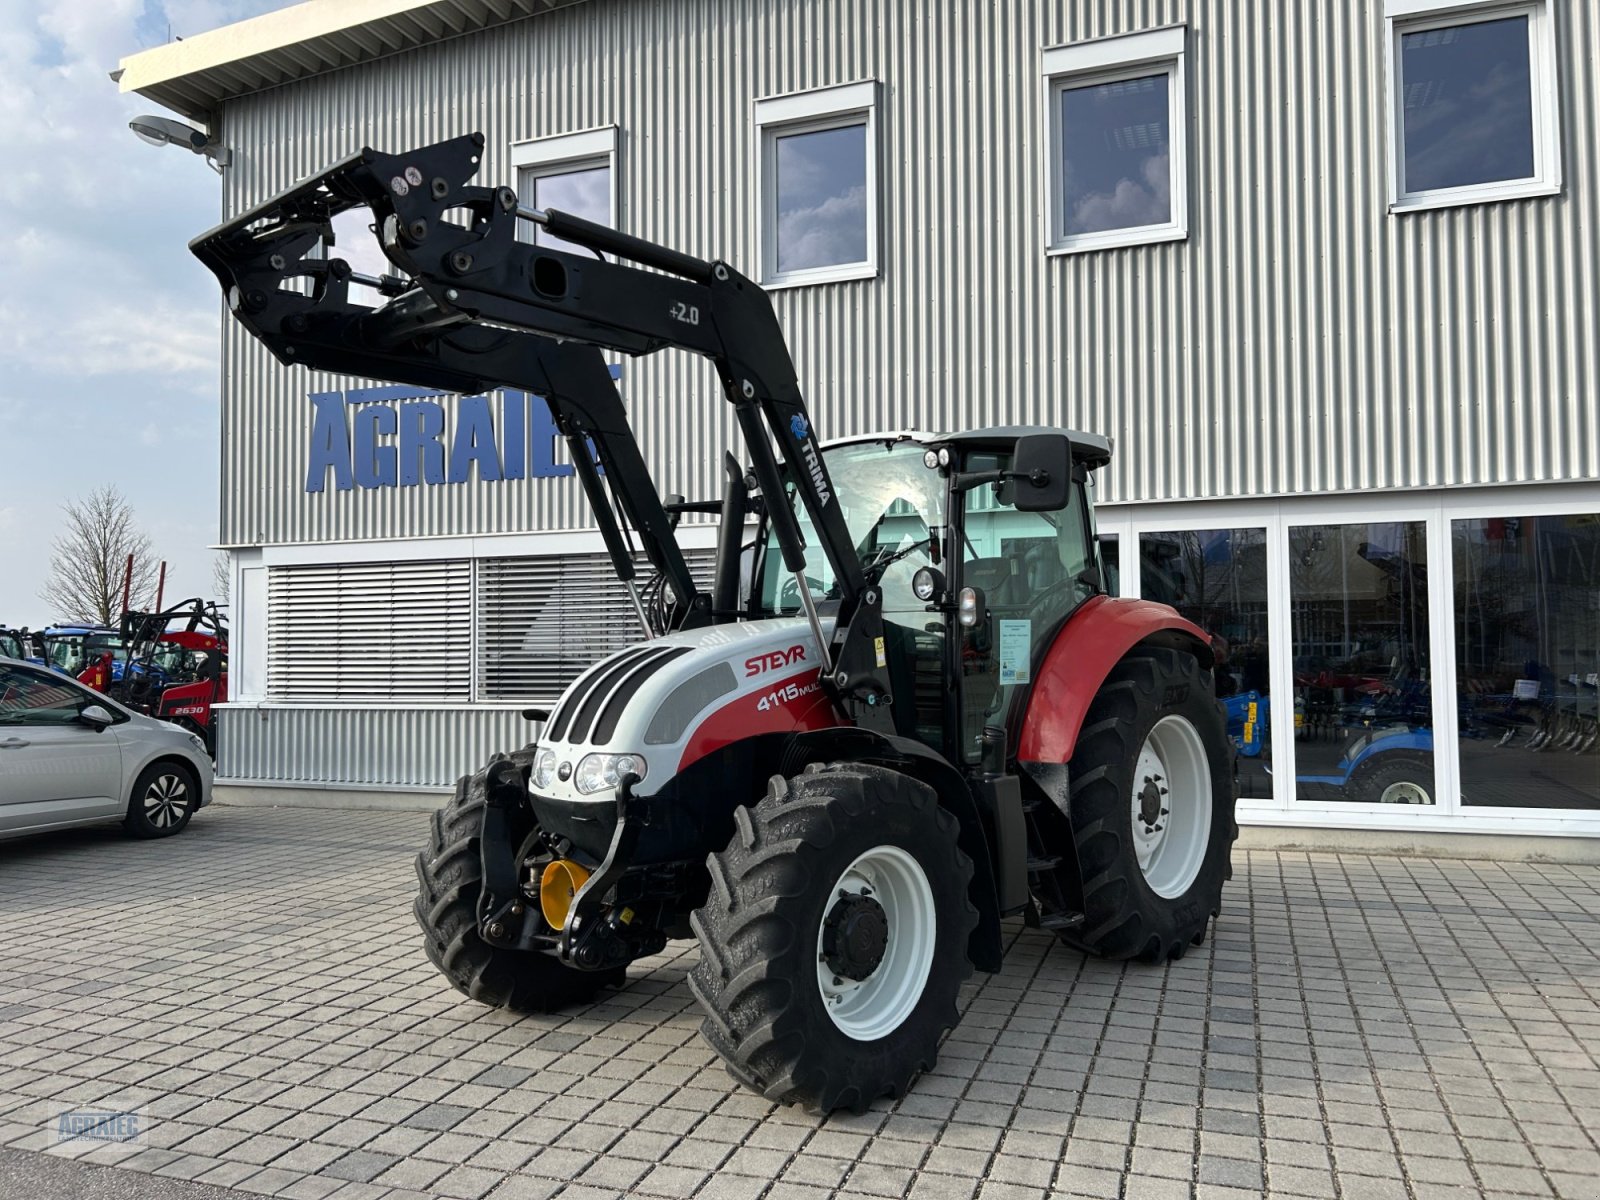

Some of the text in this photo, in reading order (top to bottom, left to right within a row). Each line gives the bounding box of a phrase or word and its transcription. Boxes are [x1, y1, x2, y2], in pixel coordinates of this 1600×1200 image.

[669, 302, 699, 325] +2.0
[305, 364, 621, 492] AGRATE
[801, 438, 831, 508] TRIMA
[744, 644, 806, 677] STEYR
[175, 706, 204, 714] 2630
[757, 683, 800, 711] 4115
